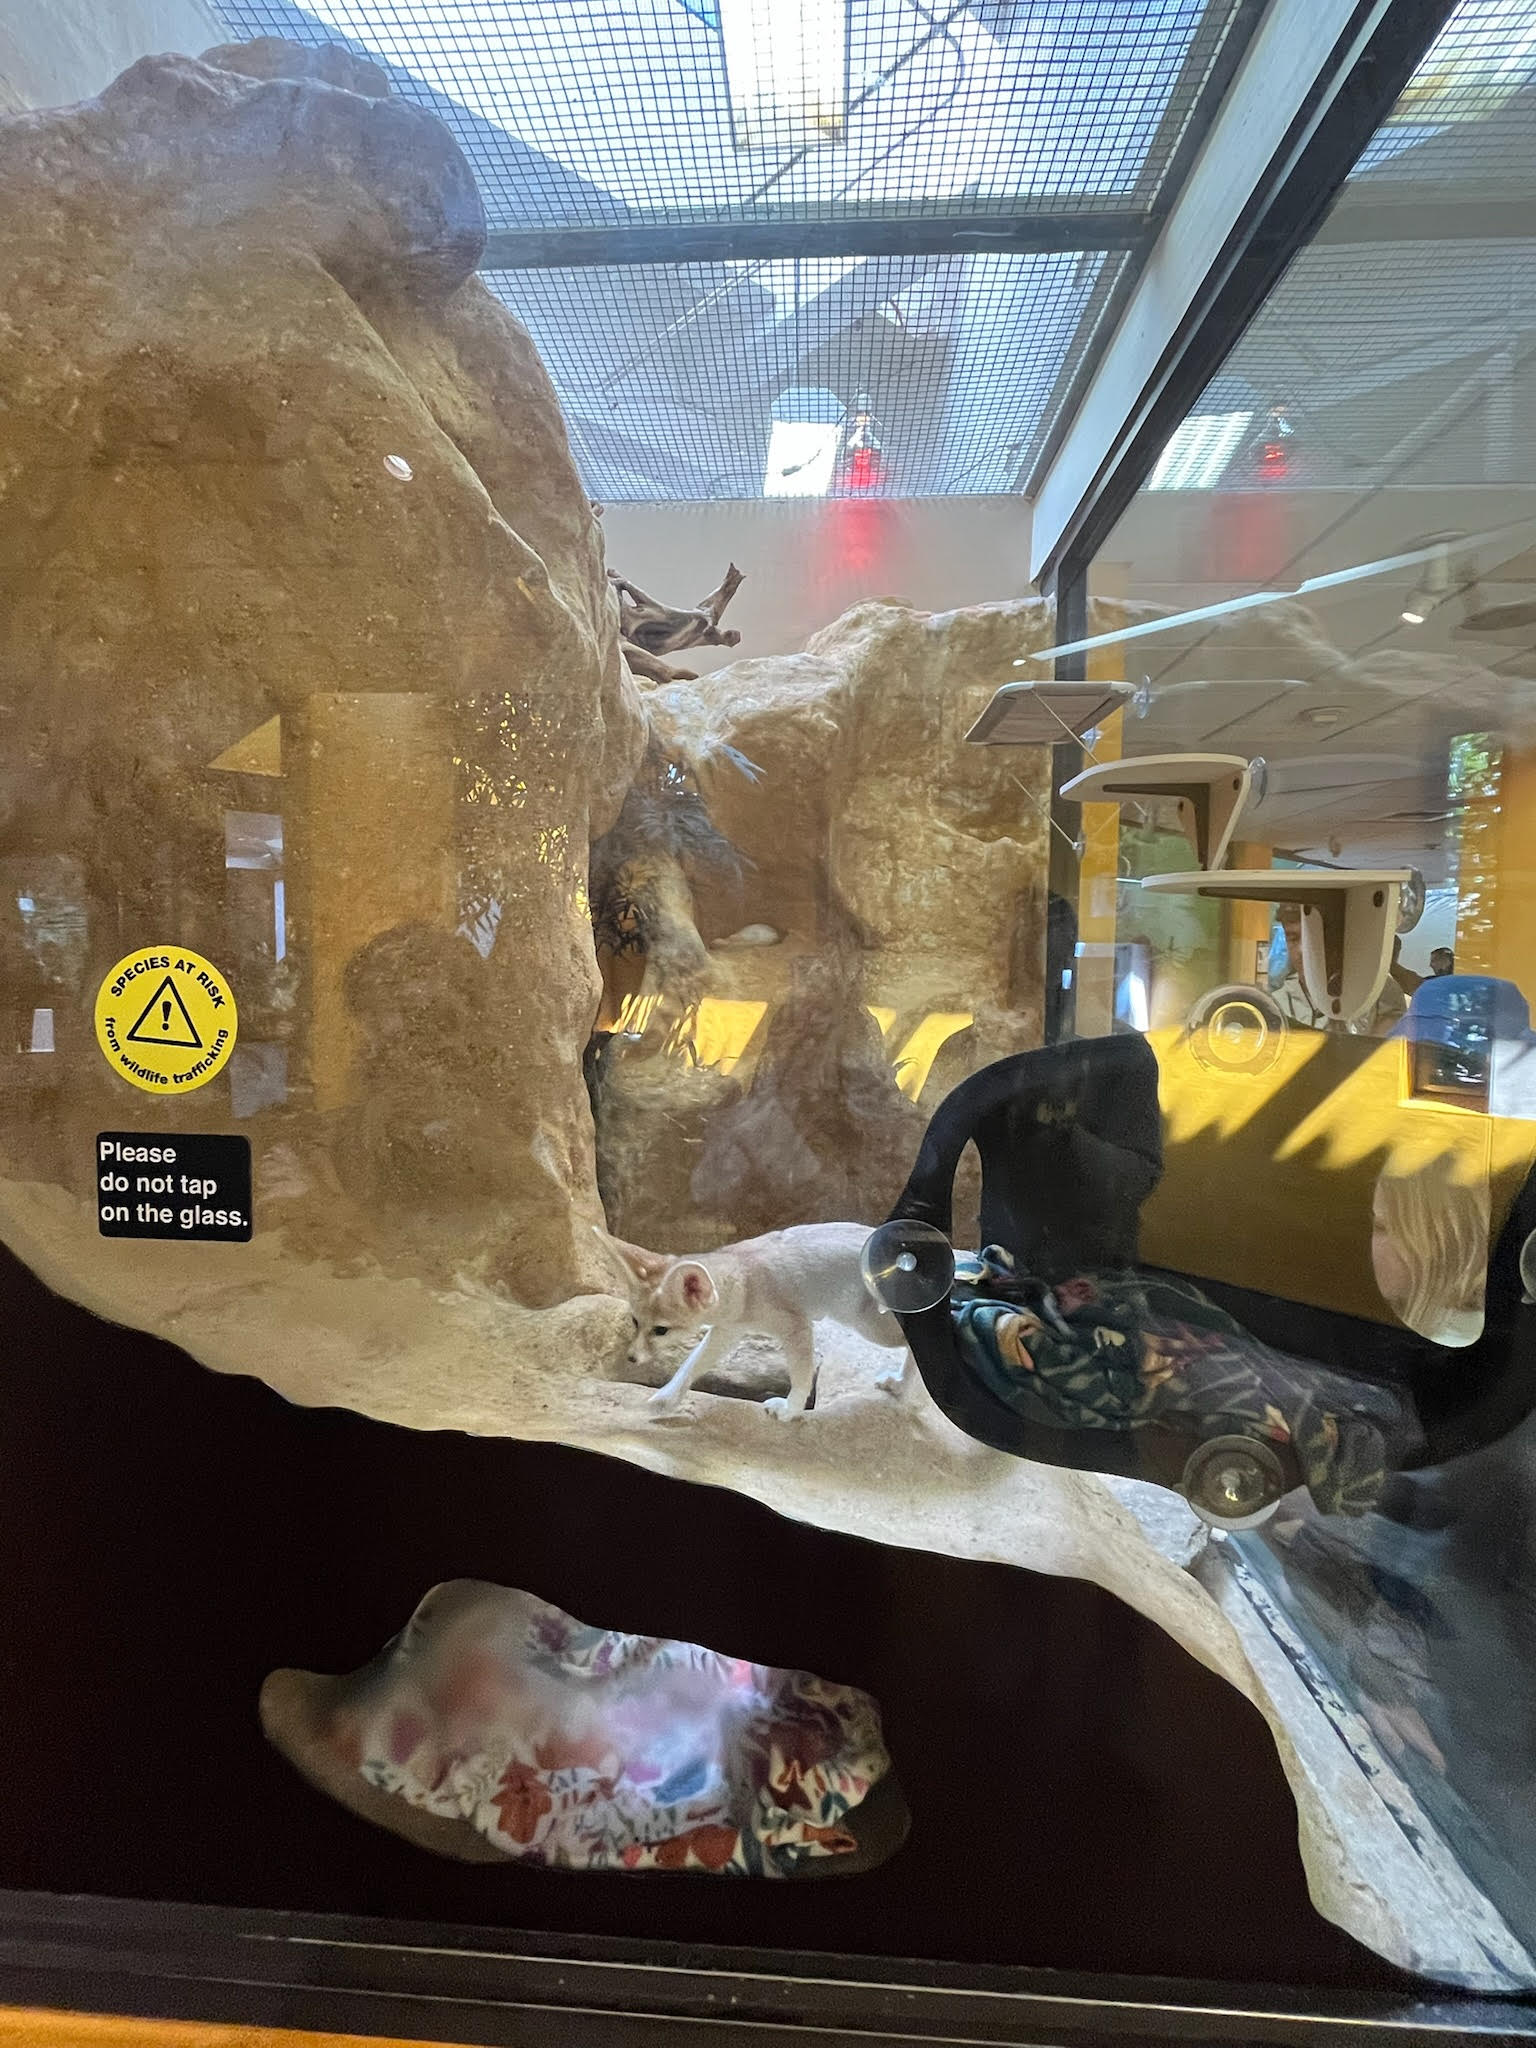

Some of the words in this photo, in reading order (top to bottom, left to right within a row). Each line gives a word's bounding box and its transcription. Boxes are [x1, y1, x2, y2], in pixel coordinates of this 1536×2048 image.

[111, 956, 170, 998] SPECIES
[174, 959, 196, 973] AT
[196, 971, 226, 1009] RISK
[105, 1017, 121, 1053] from
[120, 1055, 169, 1085] wildlife
[173, 1029, 229, 1084] trafficking
[100, 1141, 177, 1164] Please
[100, 1172, 129, 1192] do
[136, 1174, 174, 1194] not
[180, 1175, 217, 1199] tap
[101, 1204, 129, 1223] on
[136, 1203, 173, 1224] the
[179, 1205, 248, 1229] glass.
